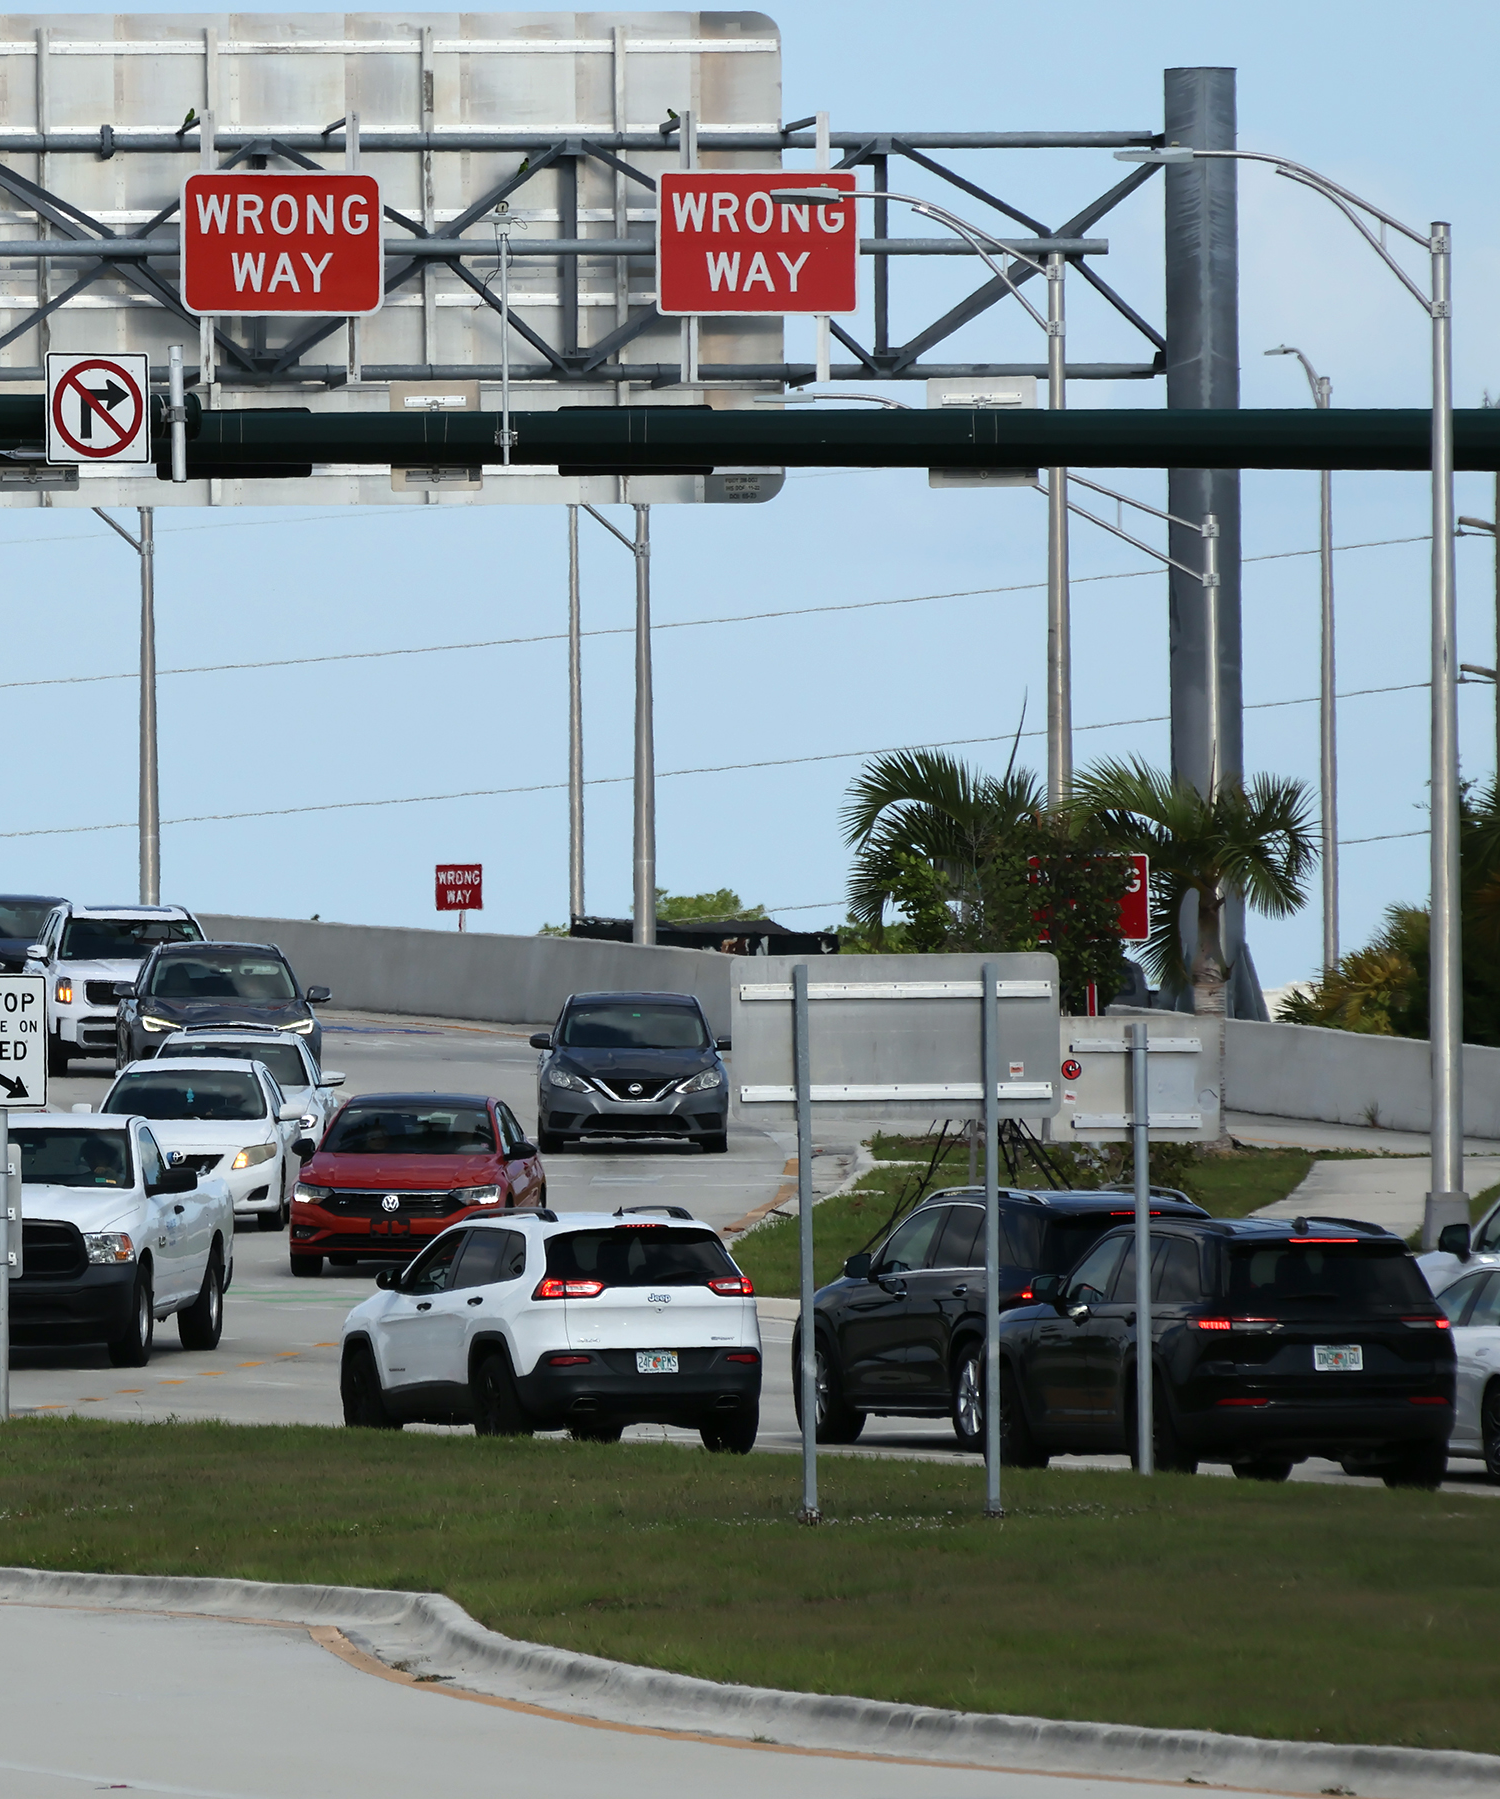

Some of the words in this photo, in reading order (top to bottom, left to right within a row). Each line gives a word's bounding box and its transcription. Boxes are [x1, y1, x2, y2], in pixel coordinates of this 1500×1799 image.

[195, 193, 369, 236] WRONG
[672, 192, 846, 234] WRONG
[231, 252, 334, 293] WAY
[705, 252, 811, 293] WAY
[437, 870, 481, 885] WRONG
[446, 889, 472, 904] WAY
[19, 1020, 38, 1033] ON
[648, 1293, 672, 1303] Jeep
